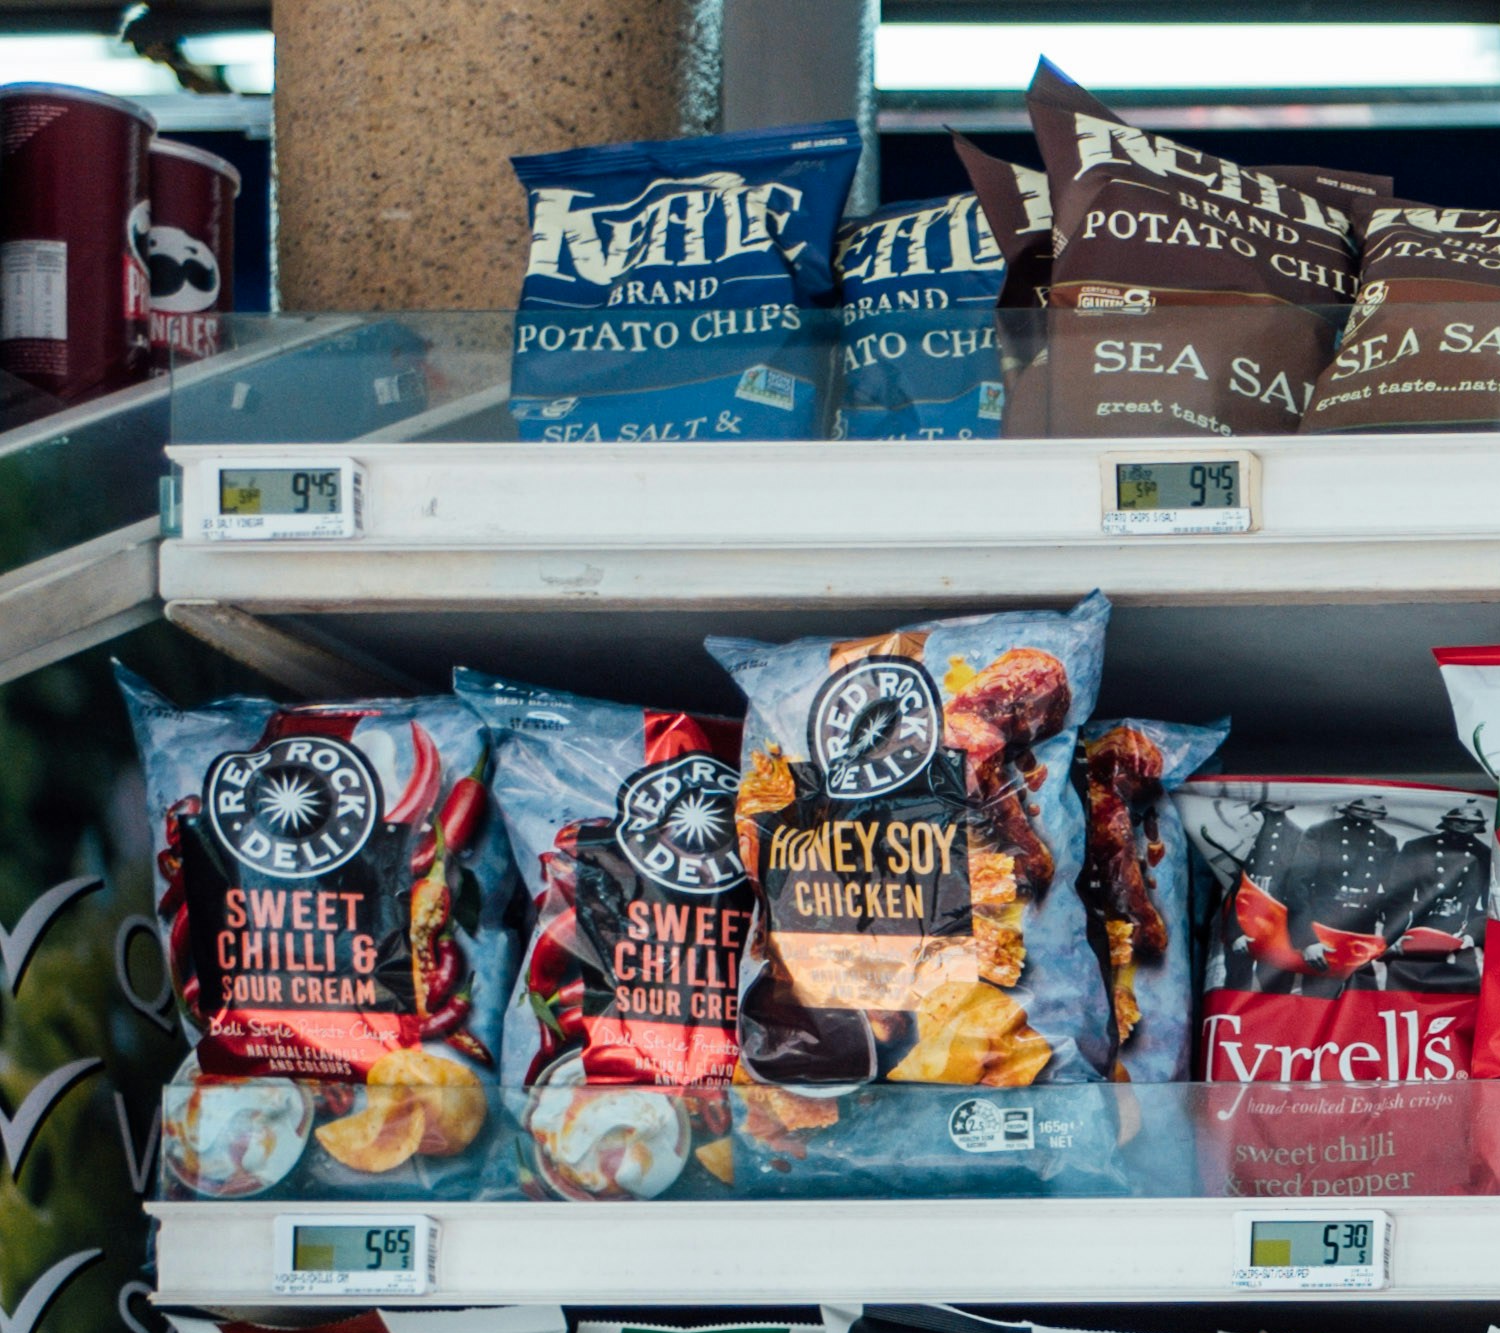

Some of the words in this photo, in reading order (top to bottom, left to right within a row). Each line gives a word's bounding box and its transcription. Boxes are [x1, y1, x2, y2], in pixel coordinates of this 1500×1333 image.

[528, 170, 805, 286] KETTLE
[608, 277, 719, 308] BRAND
[517, 312, 678, 355] POTATO
[691, 302, 802, 342] CHIPS
[1331, 324, 1422, 381] SEA
[218, 749, 271, 815] RED
[284, 741, 367, 837] ROCK
[240, 833, 345, 871] DELI
[768, 820, 880, 876] HONEY
[890, 820, 956, 880] SOY
[226, 890, 365, 933] SWEET
[794, 881, 925, 918] CHICKEN
[217, 930, 338, 974] CHILLI
[351, 939, 378, 974] &
[221, 975, 284, 1005] SOUR
[291, 976, 378, 1006] CREAM
[250, 1018, 295, 1040] Style
[300, 1020, 345, 1041] Potato
